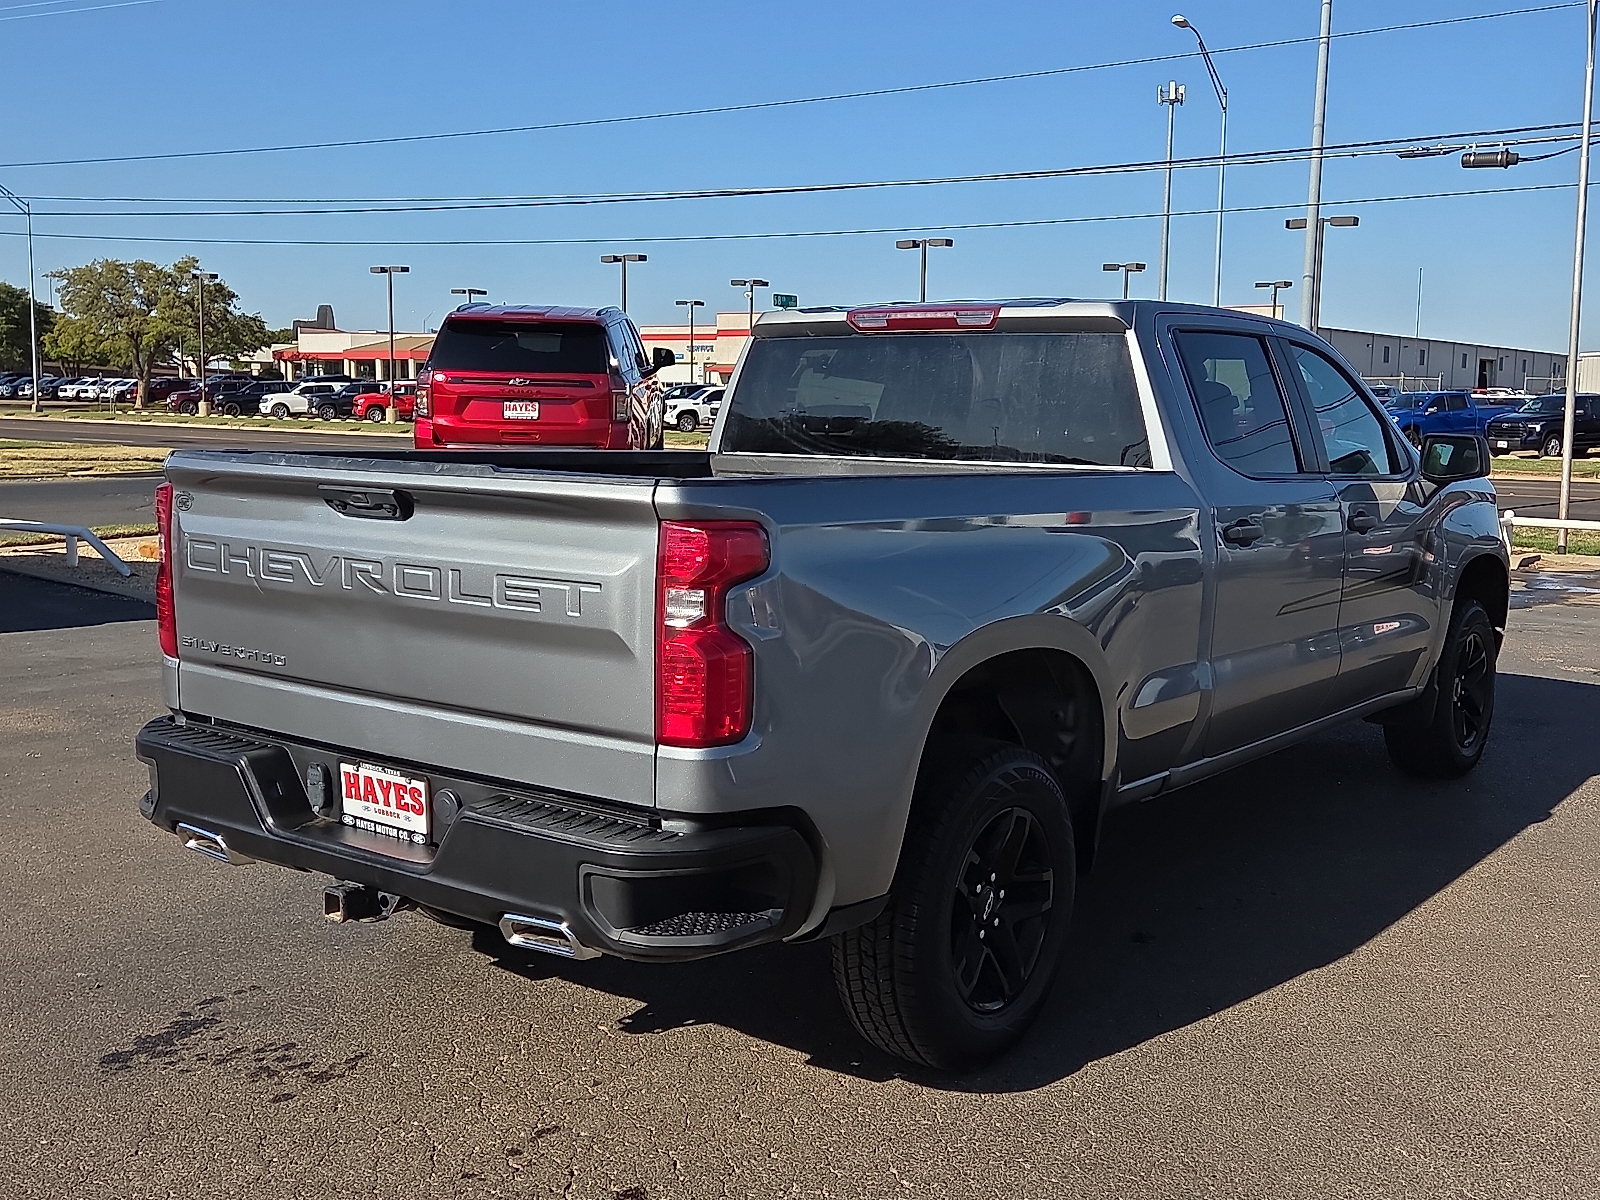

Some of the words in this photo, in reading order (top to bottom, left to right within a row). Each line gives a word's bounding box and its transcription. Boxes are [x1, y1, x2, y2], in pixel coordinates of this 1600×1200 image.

[505, 403, 537, 412] HAYES
[187, 537, 602, 617] CHEVROLET
[181, 635, 287, 666] SILVERADO
[343, 771, 424, 816] HAYES
[356, 818, 375, 832] HAYES
[376, 824, 398, 838] MOTOR
[399, 830, 410, 841] CO.
